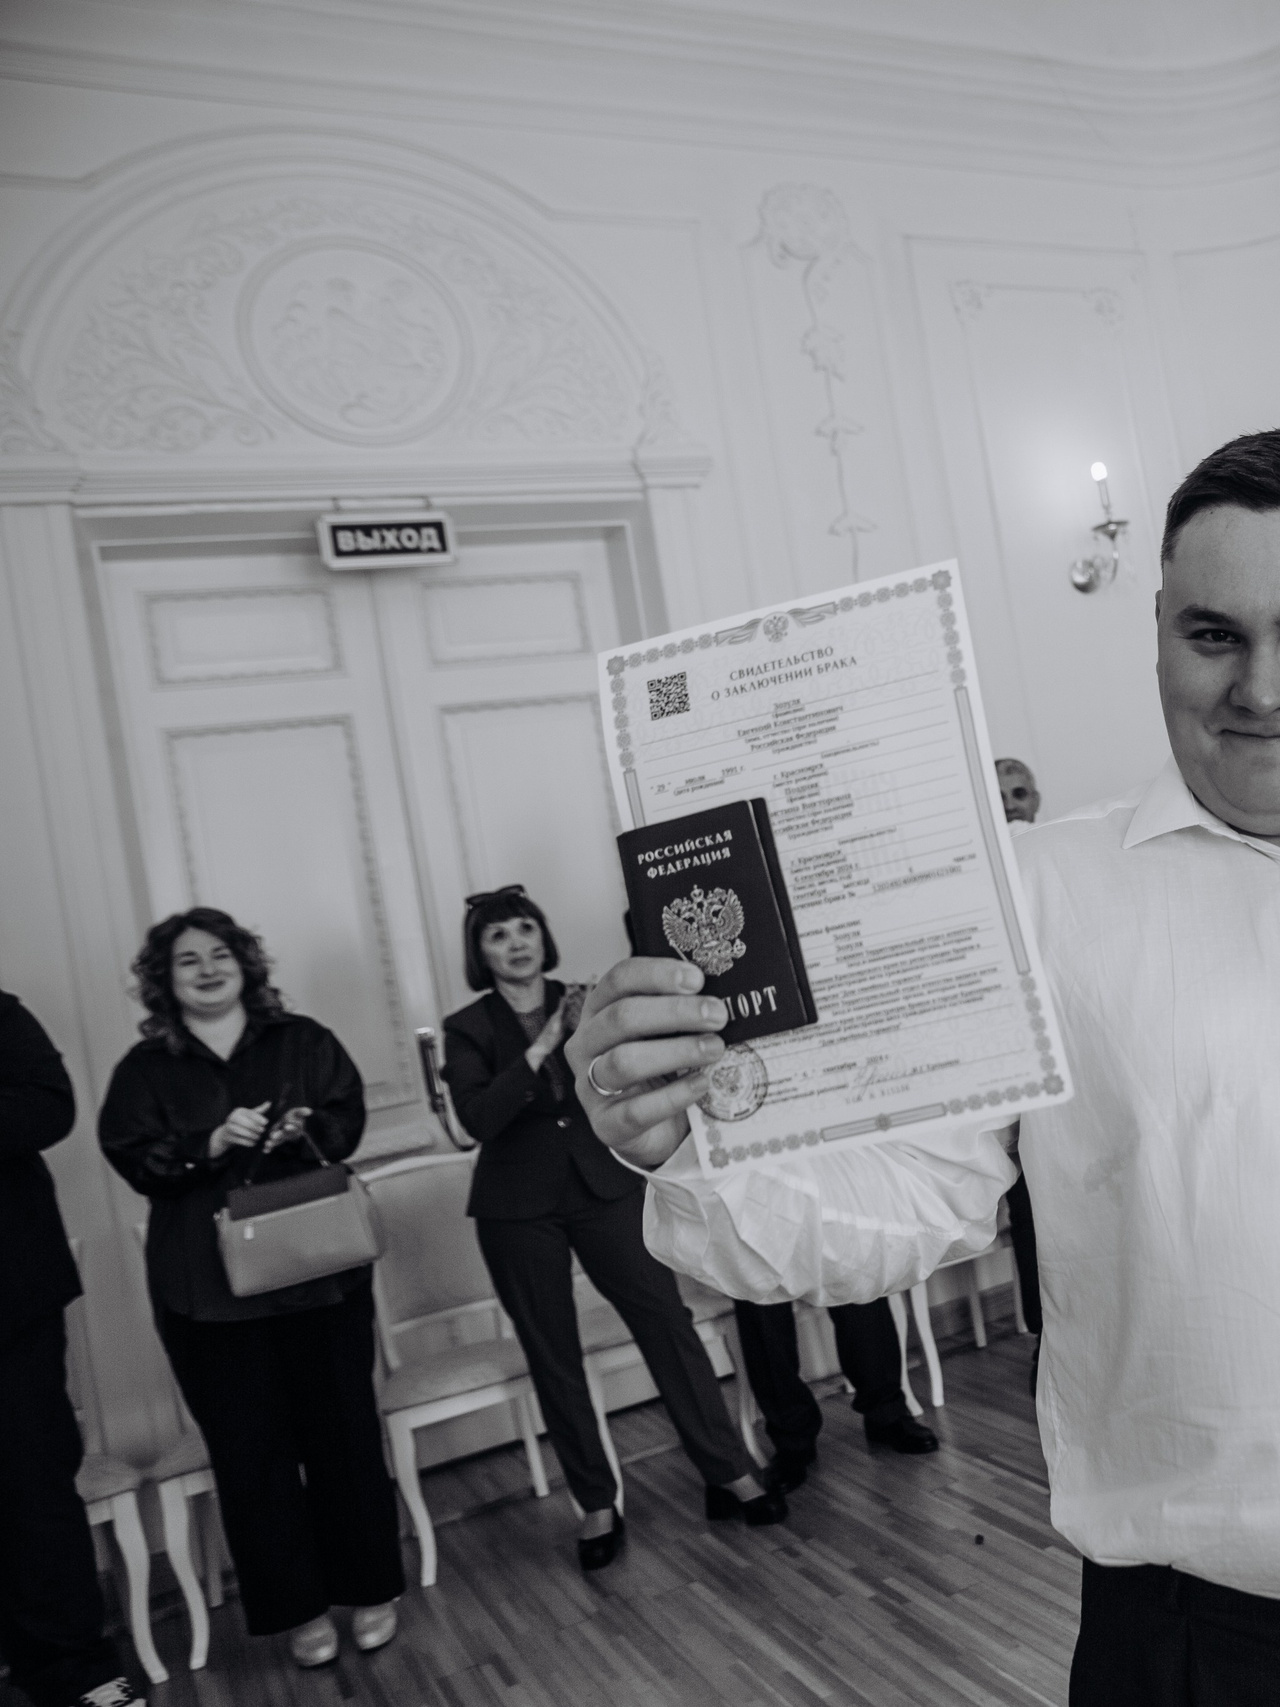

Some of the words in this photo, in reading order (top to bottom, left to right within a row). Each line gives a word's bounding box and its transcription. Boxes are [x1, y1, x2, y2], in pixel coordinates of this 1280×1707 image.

[335, 526, 443, 553] ВЫХОД
[710, 690, 721, 702] О
[724, 666, 813, 698] ЗАКЛЮЧЕНИИ
[816, 655, 858, 675] БРАКА
[729, 645, 834, 682] СВИДЕТЕЛЬСТВО
[636, 829, 734, 866] РОССИЙСКАЯ
[646, 847, 732, 880] ФЕДЕРАЦИЯ
